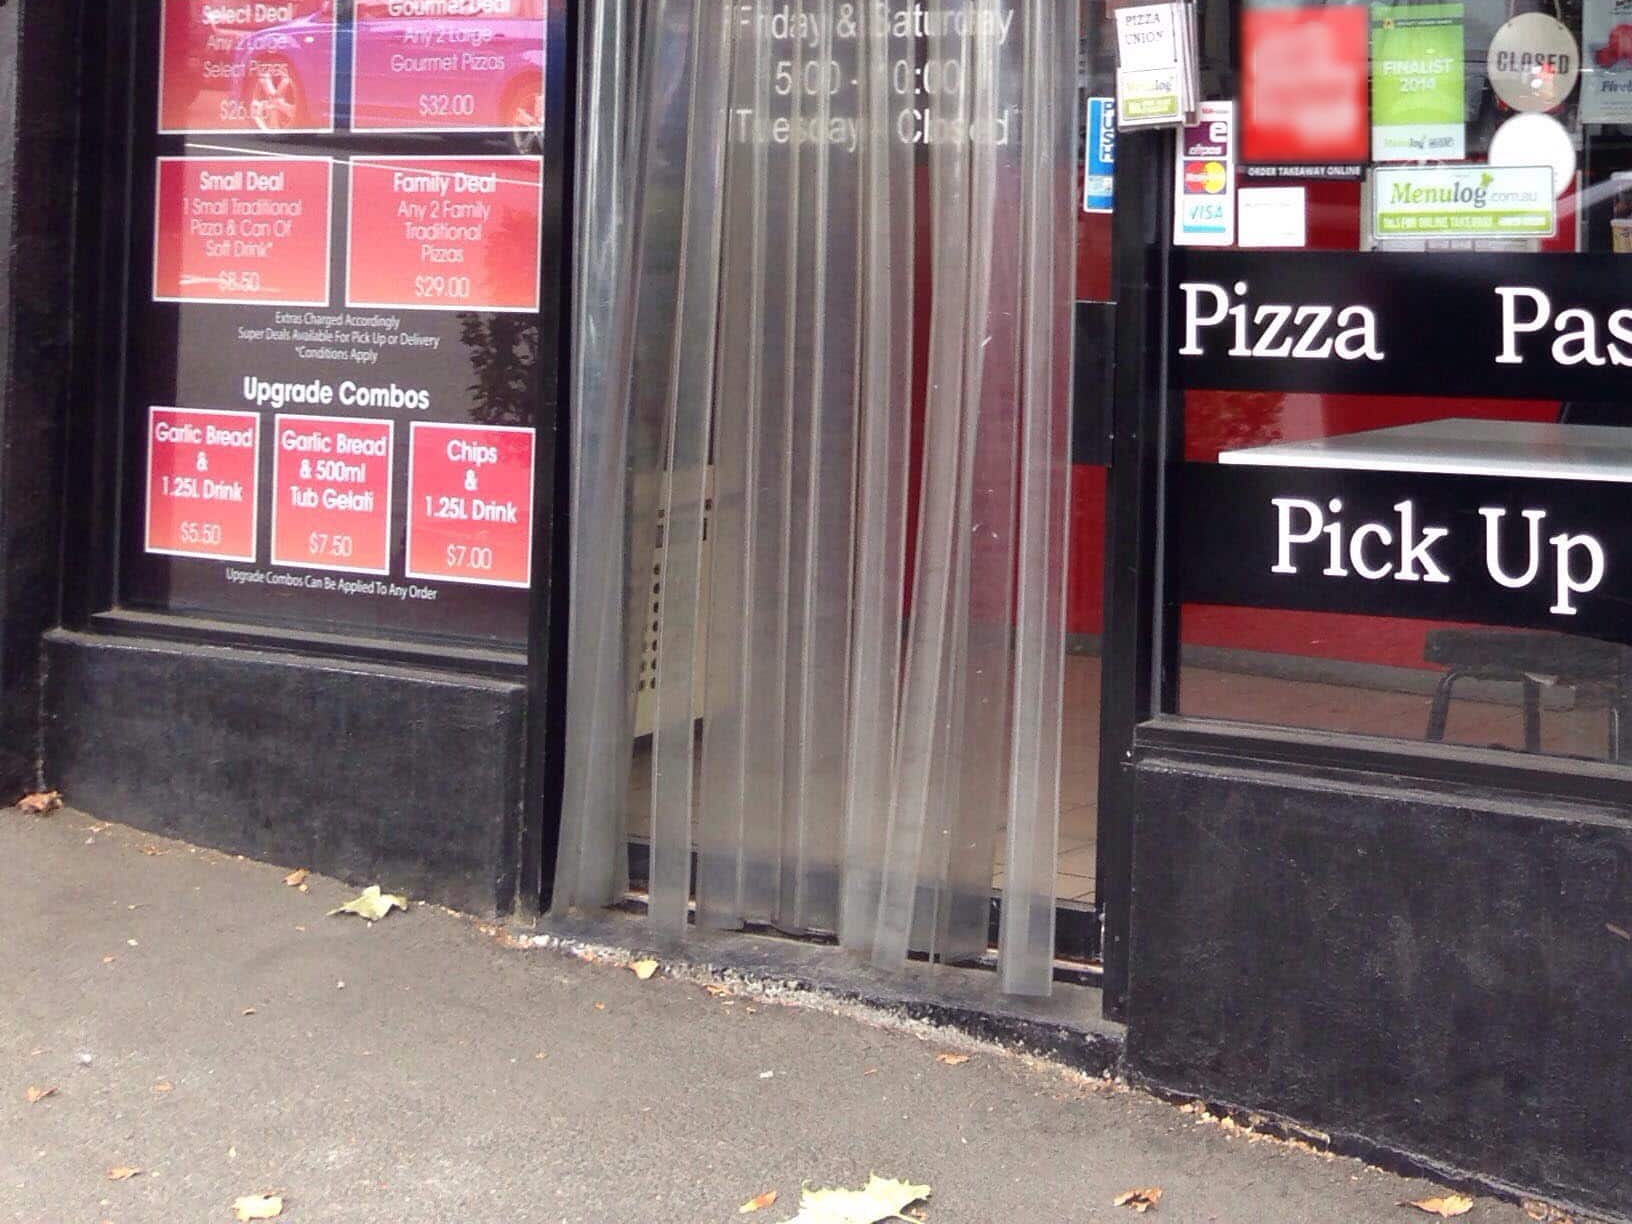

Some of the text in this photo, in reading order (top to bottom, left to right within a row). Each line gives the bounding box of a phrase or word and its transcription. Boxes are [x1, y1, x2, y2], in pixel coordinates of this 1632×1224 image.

[202, 2, 294, 25] Select Deal
[390, 53, 505, 72] Gourmet Pizzas
[1496, 51, 1571, 75] CLOSED
[418, 94, 475, 116] $32.00
[200, 170, 285, 191] Small Deal
[393, 171, 498, 197] Family Deal
[192, 197, 229, 216] Small
[231, 197, 302, 217] Traditional
[397, 200, 492, 223] Any 2 Family
[1191, 204, 1223, 220] VISA
[190, 218, 224, 237] Pizza
[404, 221, 483, 242] Traditional
[421, 243, 465, 263] Pizzas
[415, 275, 472, 298] $29.00
[274, 311, 402, 331] Extras Charged Accordingly
[1178, 281, 1385, 362] Pizza
[238, 326, 265, 342] Super
[265, 327, 292, 341] Deals
[292, 329, 334, 343] Available
[335, 330, 350, 344] For
[351, 331, 371, 345] Pick
[373, 332, 387, 347] Up
[400, 332, 441, 350] Delivery
[350, 348, 379, 364] Apply
[243, 376, 431, 411] Upgrade Combos
[155, 422, 254, 449] Garlic Bread
[281, 430, 388, 457] Garlic Bread
[196, 452, 209, 472] &
[446, 439, 499, 465] Chips
[299, 460, 367, 484] & 500ml
[464, 470, 479, 492] &
[161, 479, 244, 503] 1.25L Drink
[289, 486, 375, 512] Tub Gelati
[425, 496, 519, 524] 1.25L Drink
[180, 521, 222, 546] $5.50
[309, 531, 354, 558] $7.50
[446, 545, 494, 571] $7.00
[1270, 496, 1452, 584] Pick
[1479, 504, 1606, 616] Up
[225, 567, 438, 601] Upgrade Combos Can Be Applied To Any Order
